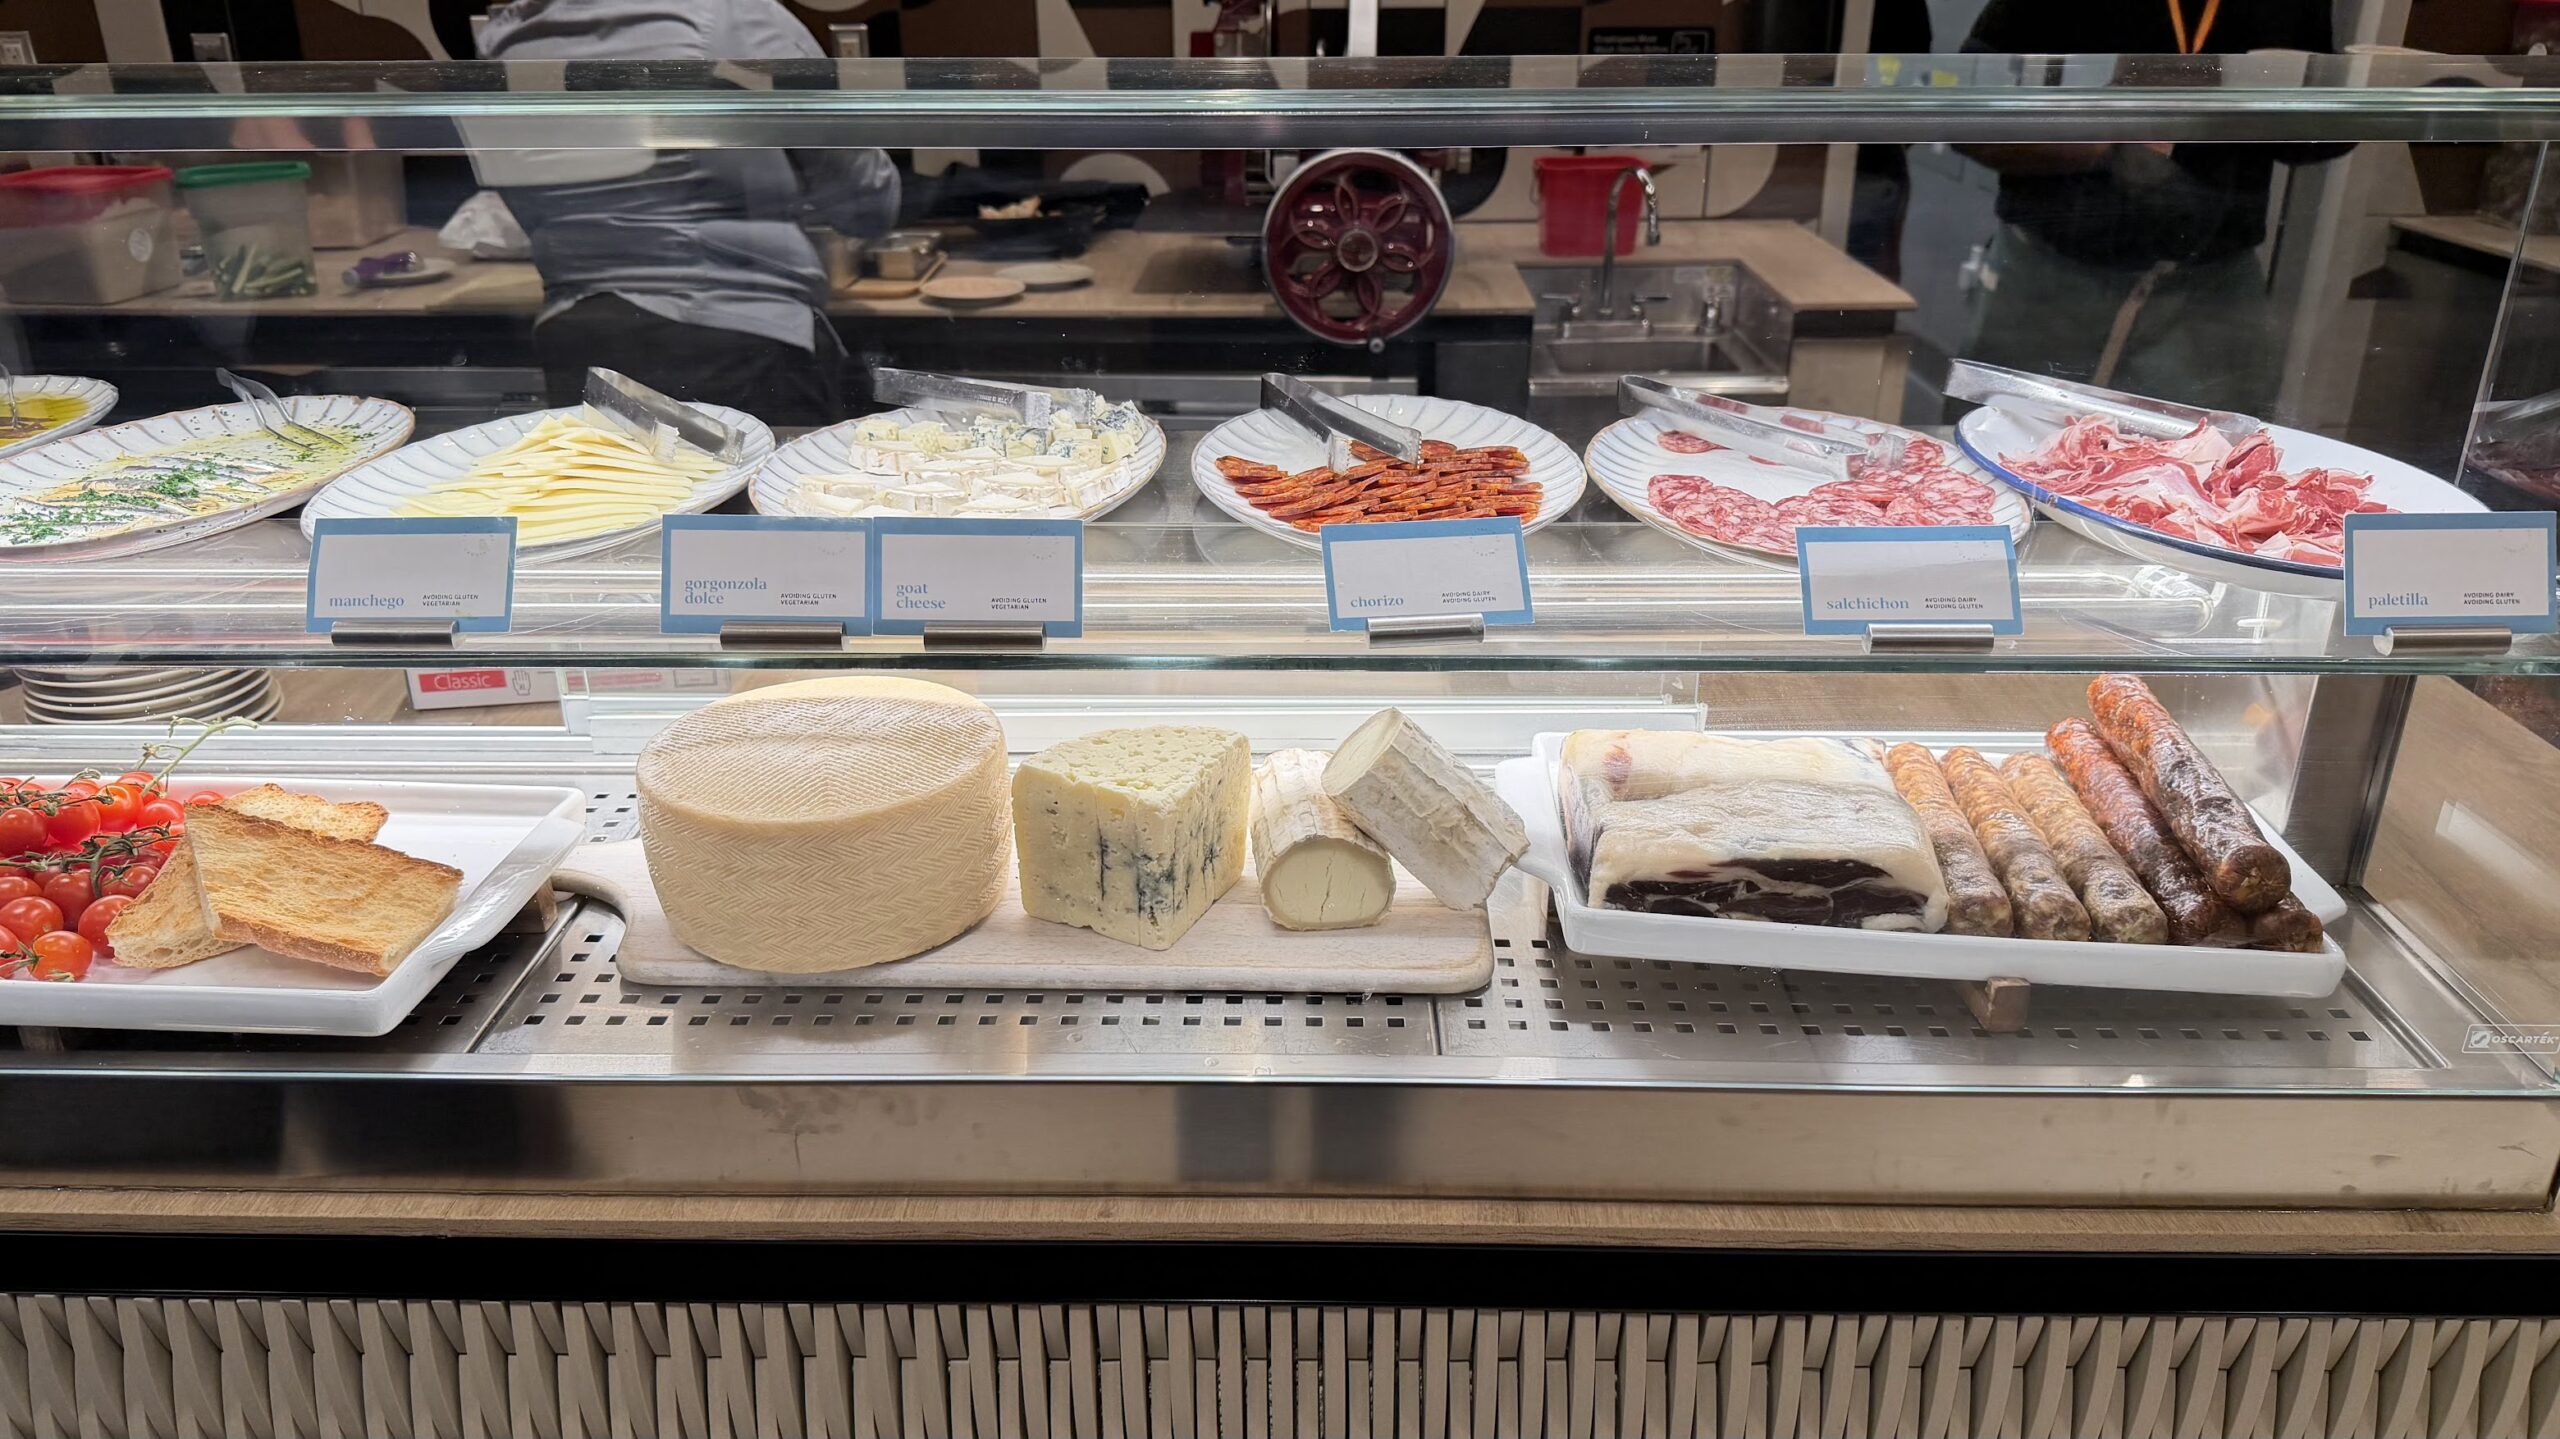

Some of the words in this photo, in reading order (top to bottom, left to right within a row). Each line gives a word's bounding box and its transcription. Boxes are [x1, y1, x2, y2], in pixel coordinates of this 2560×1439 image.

[685, 577, 767, 593] gorgonzola
[896, 582, 928, 596] goat
[329, 594, 405, 609] manchego
[685, 591, 724, 605] dolce
[896, 596, 946, 609] cheese
[1350, 595, 1404, 608] chorizo
[1826, 597, 1909, 610] salchichon
[2368, 592, 2429, 609] paletilla
[434, 673, 491, 690] Classic
